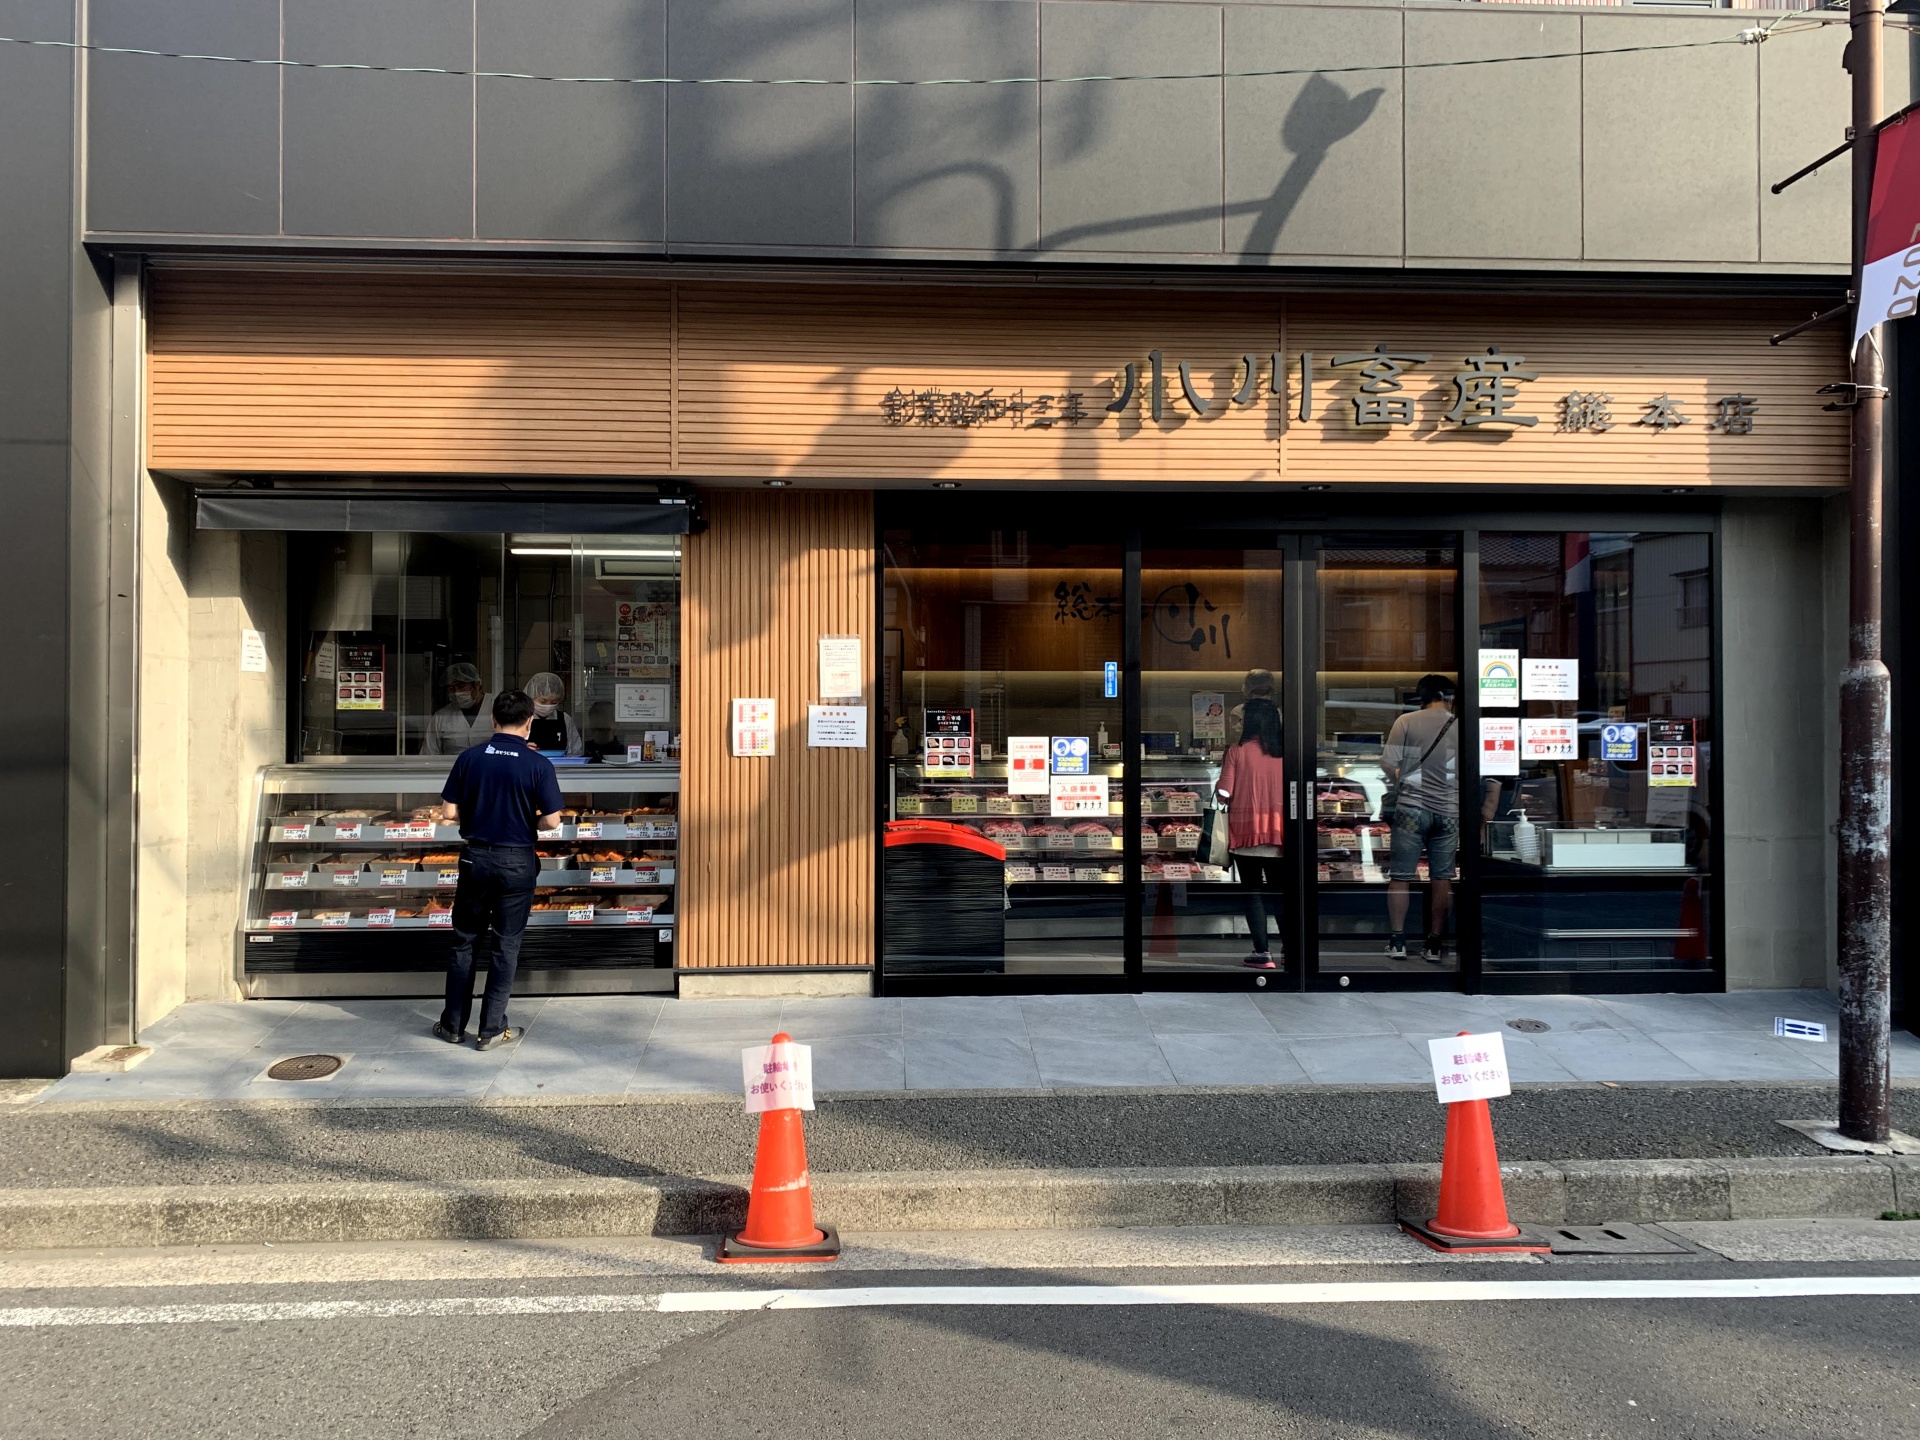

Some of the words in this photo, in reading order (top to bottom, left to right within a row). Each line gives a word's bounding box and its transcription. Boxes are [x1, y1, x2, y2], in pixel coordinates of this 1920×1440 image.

[886, 386, 1089, 428] 創業昭和十三年
[1105, 348, 1541, 432] 小川畜産
[1566, 390, 1759, 432] 総本店
[1055, 581, 1147, 625] 総本
[1441, 1070, 1504, 1086] お使いください
